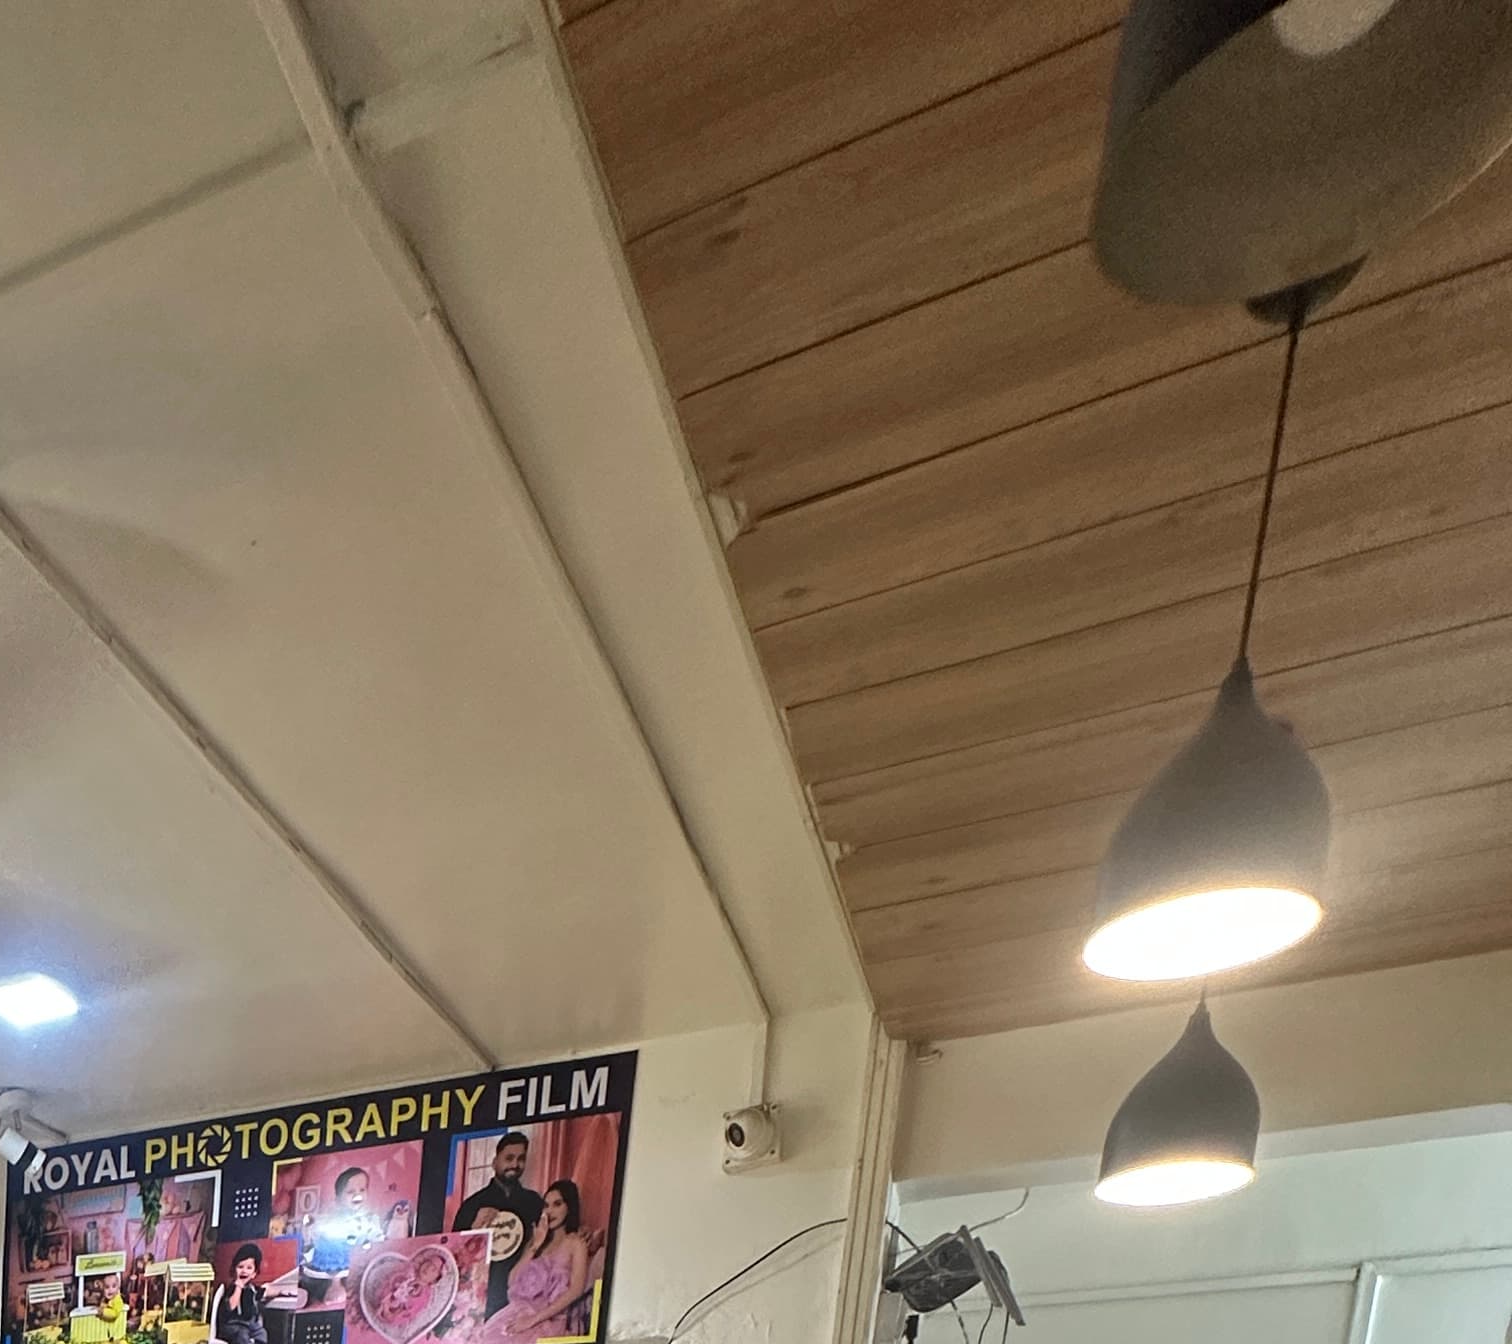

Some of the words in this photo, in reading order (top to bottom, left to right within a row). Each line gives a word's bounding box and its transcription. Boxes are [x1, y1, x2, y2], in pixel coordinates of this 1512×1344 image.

[23, 1145, 136, 1195] ROYAL
[145, 1085, 486, 1174] PHOTOGRAPHY
[497, 1066, 609, 1121] FILM
